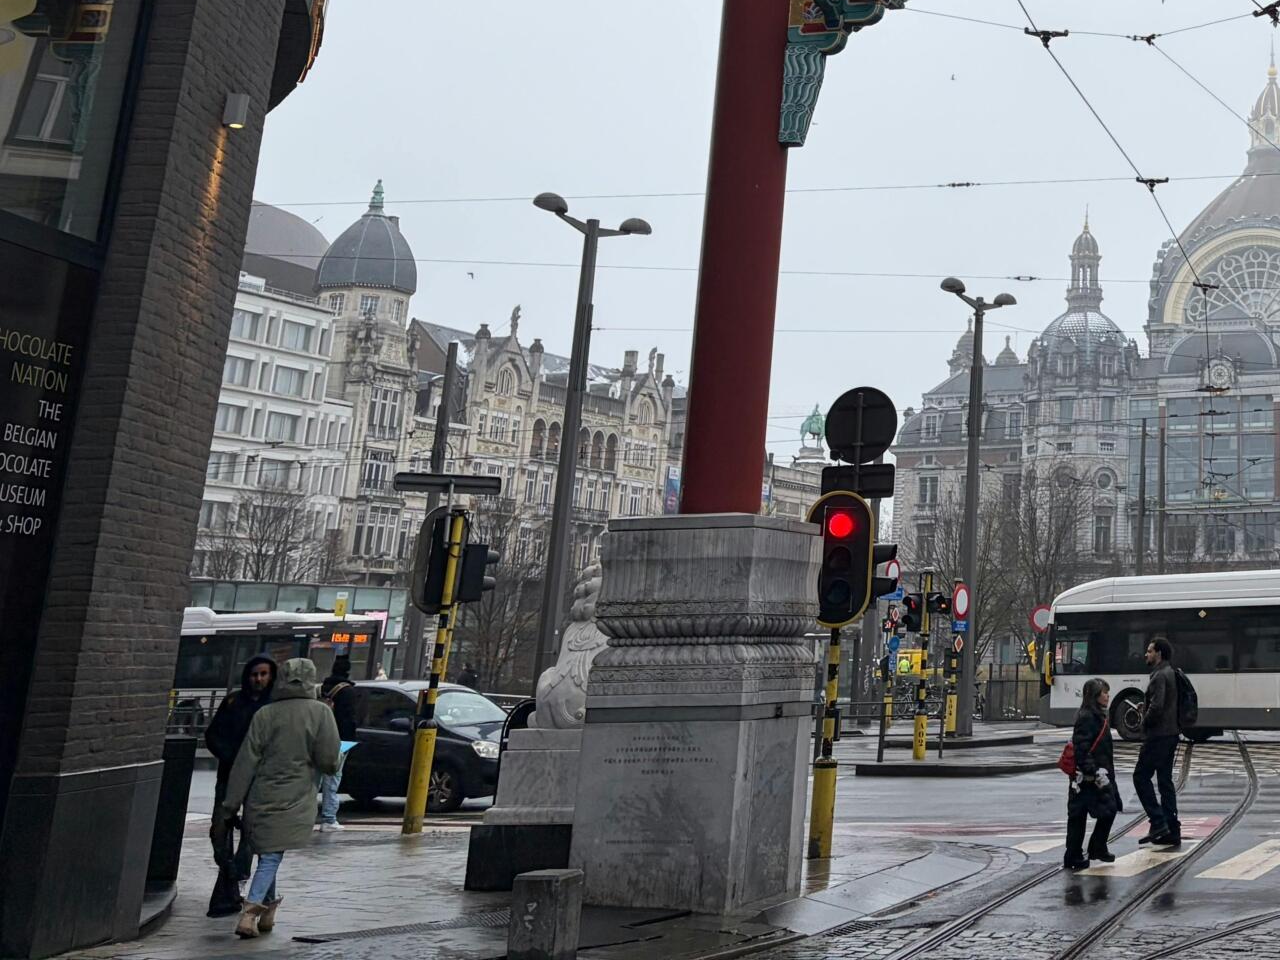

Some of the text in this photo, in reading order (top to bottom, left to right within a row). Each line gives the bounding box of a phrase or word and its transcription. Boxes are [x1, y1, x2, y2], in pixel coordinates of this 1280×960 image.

[0, 328, 73, 365] HOCOLATE
[11, 361, 68, 393] NATION
[39, 399, 63, 422] THE
[4, 423, 57, 450] BELGIAN
[0, 452, 52, 478] OCOLATE
[0, 483, 46, 507] USEUM
[6, 514, 42, 536] SHOP
